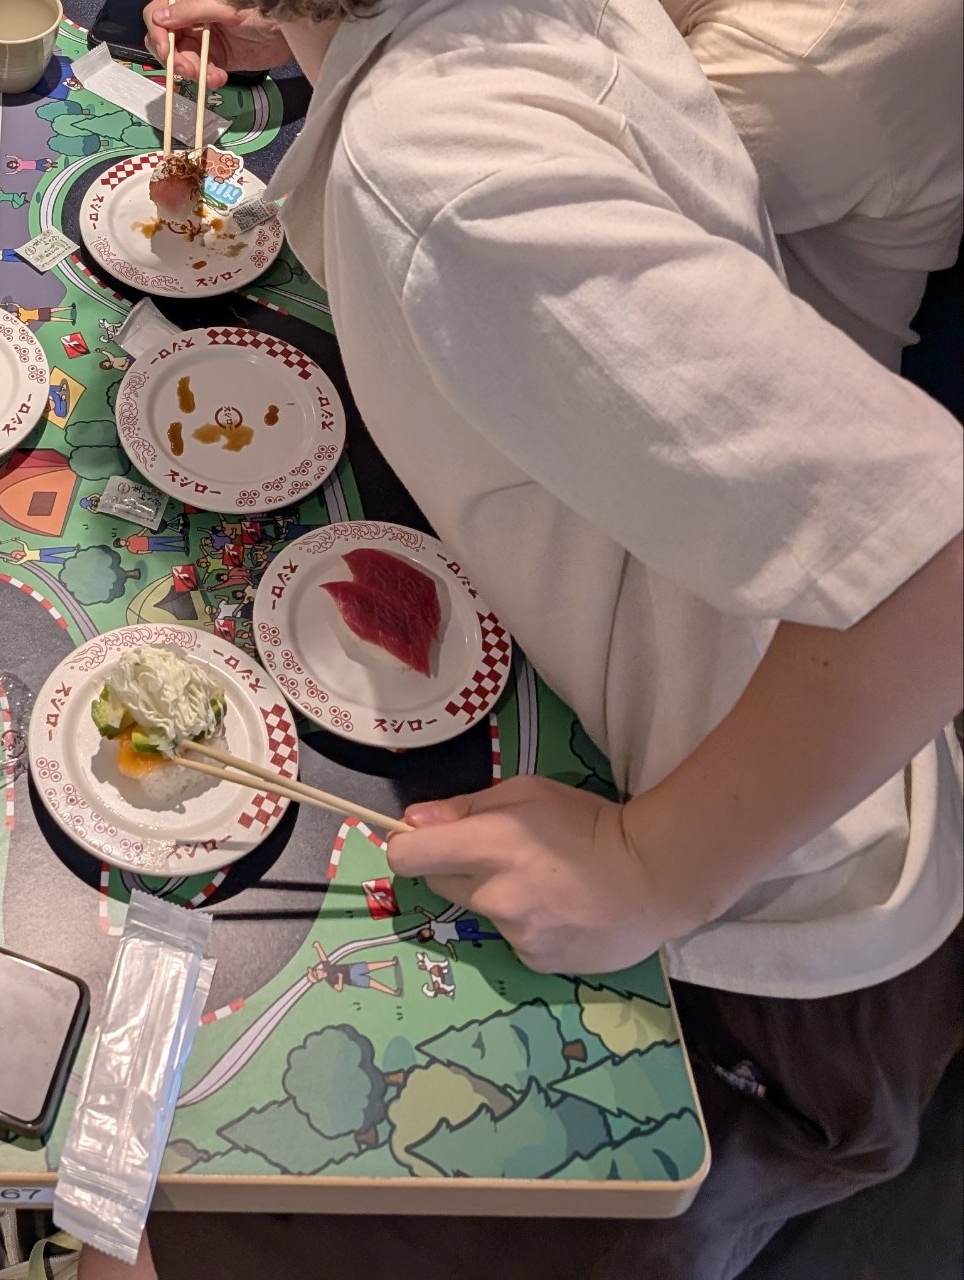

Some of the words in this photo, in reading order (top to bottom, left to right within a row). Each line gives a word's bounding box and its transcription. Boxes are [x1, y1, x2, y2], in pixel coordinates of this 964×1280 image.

[90, 194, 104, 230] スシロー
[195, 268, 243, 287] スシロー
[150, 336, 196, 365] スシロー
[1, 393, 33, 437] スシロー
[316, 386, 335, 433] スシロー
[163, 469, 221, 495] スシロー
[271, 558, 299, 610] スシロー
[437, 553, 479, 599] スシロー
[213, 648, 267, 695] スシロー
[46, 681, 73, 741] スシロー
[373, 717, 438, 733] スシロー
[166, 835, 232, 860] スシロー
[0, 1188, 41, 1200] 67
